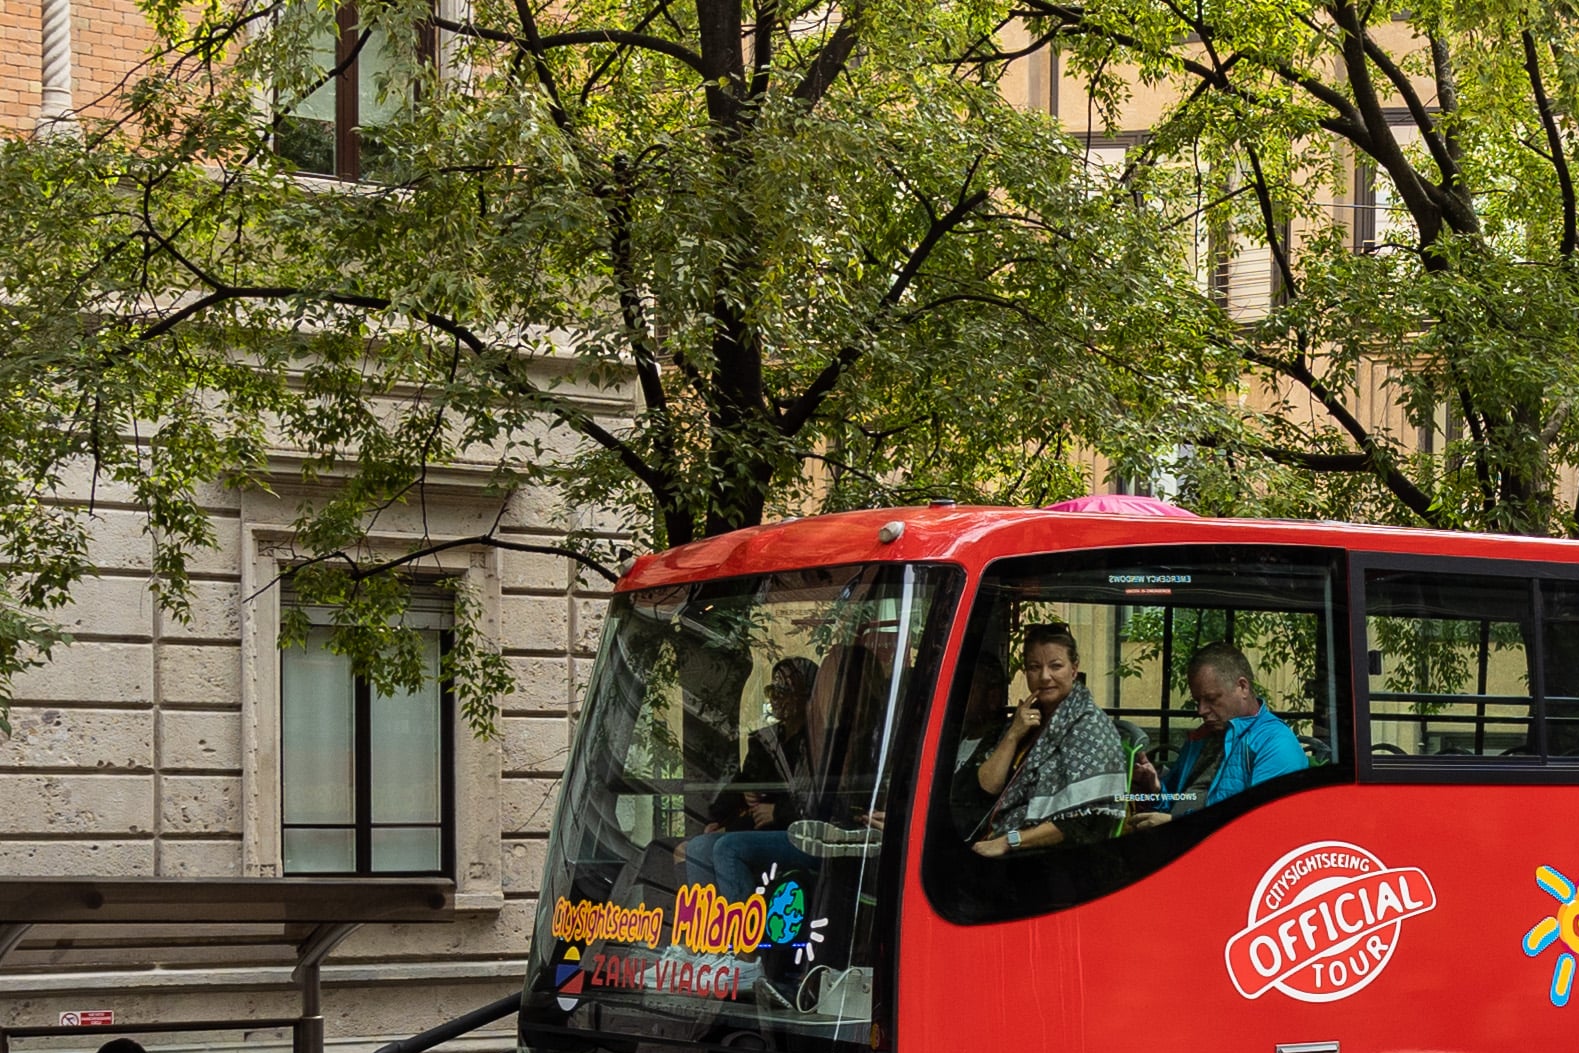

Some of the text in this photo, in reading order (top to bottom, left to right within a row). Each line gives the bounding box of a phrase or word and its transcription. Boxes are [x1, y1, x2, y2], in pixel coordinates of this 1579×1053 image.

[1114, 793, 1197, 802] EMERGENCY WINDOWS
[1265, 853, 1370, 910] CITYSIGHTSEEING
[672, 883, 766, 954] Milano
[1249, 875, 1424, 978] OFFICIAL
[591, 954, 740, 1000] ZANI VIAGGI
[1312, 935, 1389, 988] TOUR
